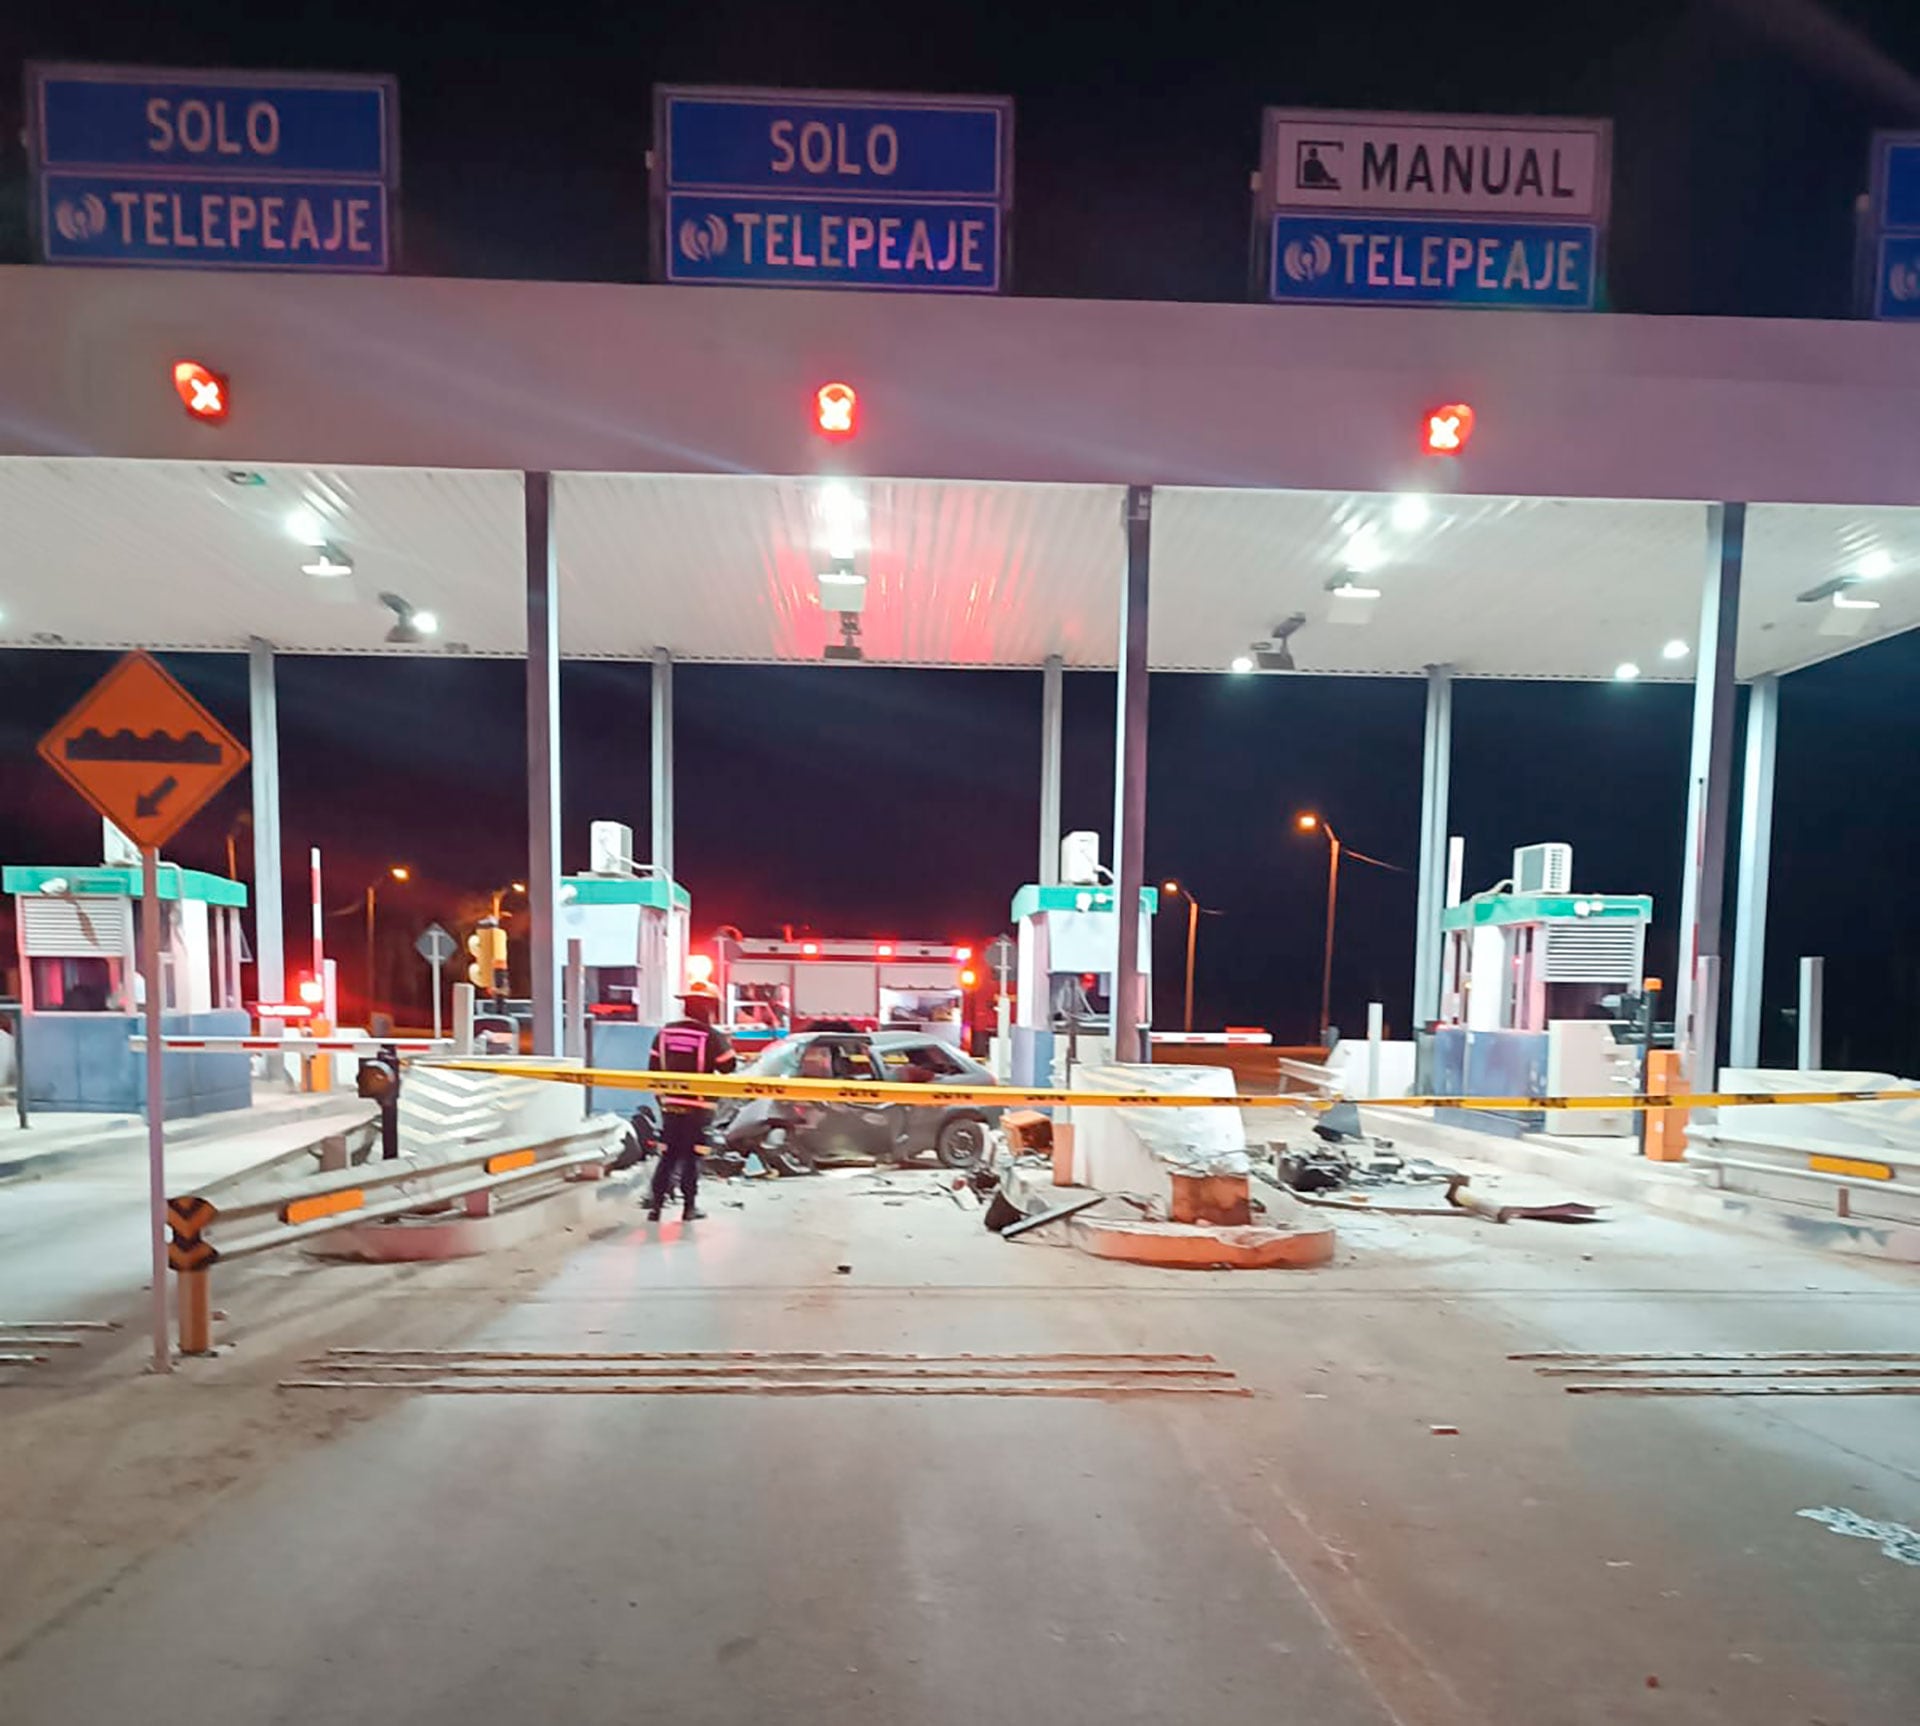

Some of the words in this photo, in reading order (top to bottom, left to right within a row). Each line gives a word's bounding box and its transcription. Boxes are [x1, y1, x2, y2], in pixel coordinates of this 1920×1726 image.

[147, 99, 279, 154] SOLO
[770, 121, 898, 175] SOLO
[1362, 142, 1575, 198] MANUAL
[113, 193, 371, 251] TELEPEAJE
[734, 214, 983, 271] TELEPEAJE
[1339, 235, 1580, 290] TELEPEAJE
